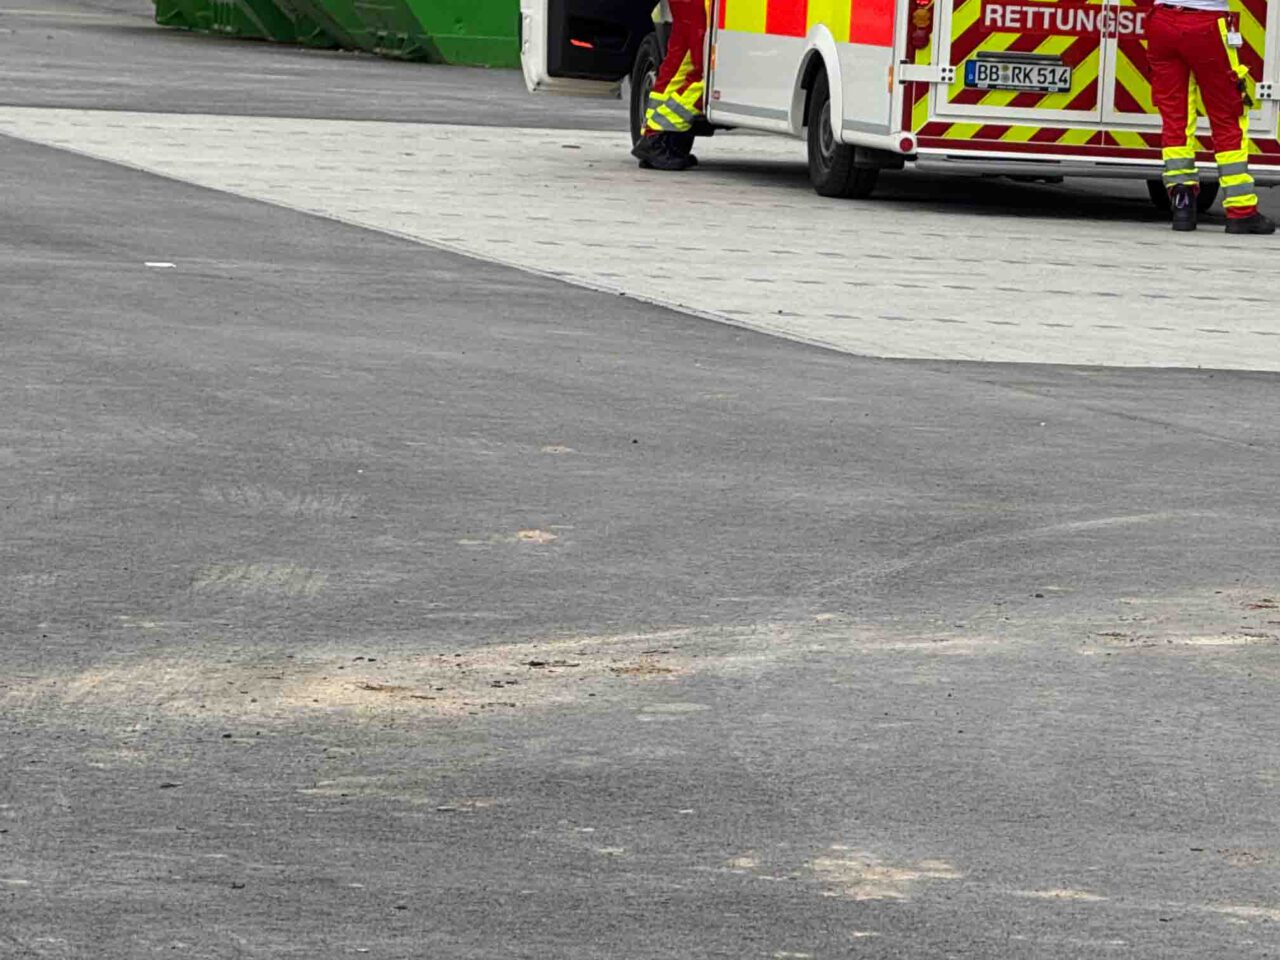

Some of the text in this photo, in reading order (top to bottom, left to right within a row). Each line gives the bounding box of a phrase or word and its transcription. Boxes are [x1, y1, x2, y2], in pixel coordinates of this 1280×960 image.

[984, 4, 1146, 35] RETTUNGSD
[977, 64, 1000, 82] BB
[1011, 66, 1034, 85] RK
[1037, 68, 1069, 86] 514
